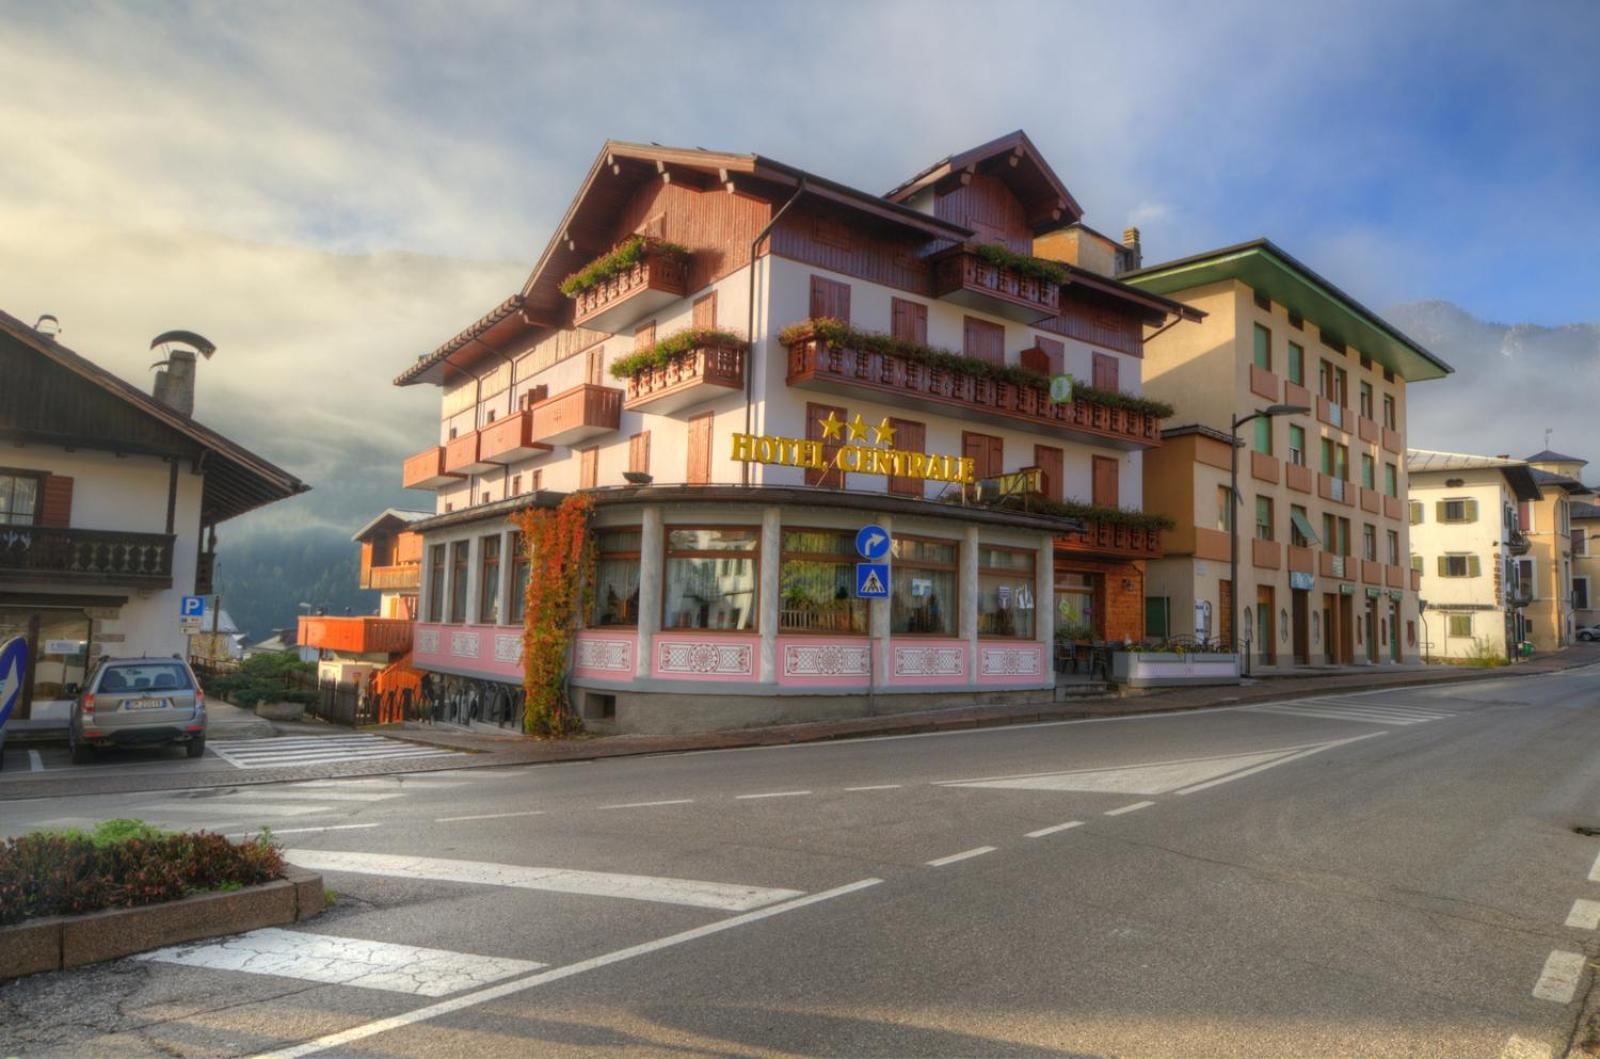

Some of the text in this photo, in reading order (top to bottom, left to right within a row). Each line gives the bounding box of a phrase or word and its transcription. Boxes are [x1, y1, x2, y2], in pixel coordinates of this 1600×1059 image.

[731, 432, 976, 484] HOTEL CENTRALE
[186, 598, 200, 614] P
